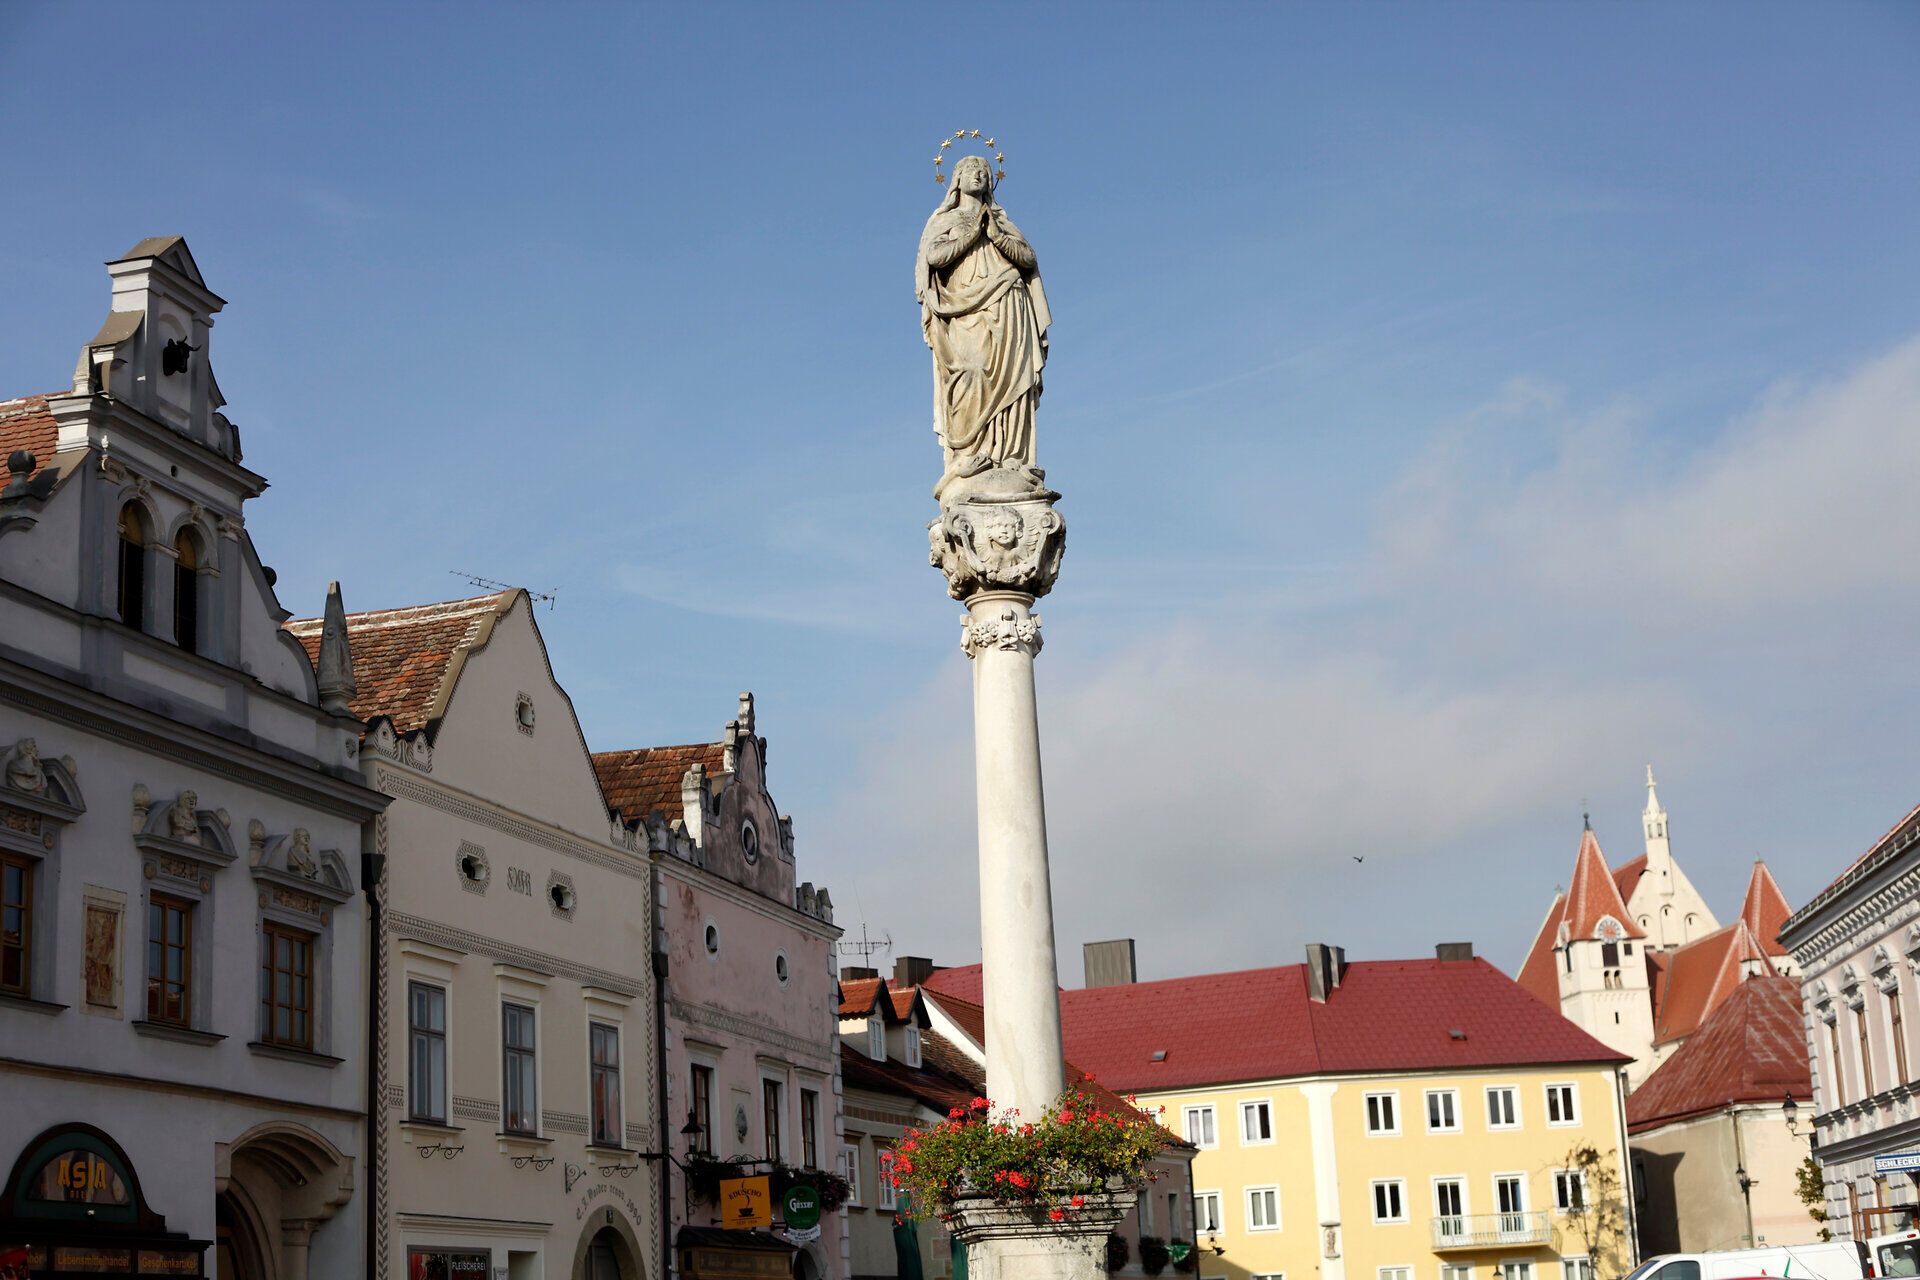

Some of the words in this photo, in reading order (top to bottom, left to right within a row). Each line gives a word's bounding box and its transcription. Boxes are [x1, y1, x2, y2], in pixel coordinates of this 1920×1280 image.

[1876, 1157, 1920, 1169] SCHLECKE
[57, 1159, 107, 1190] ASIA
[728, 1187, 762, 1201] EDUSCHO
[626, 1198, 642, 1226] 1990
[57, 1254, 129, 1267] Lebensmittelhandel
[142, 1256, 196, 1270] Geschenkartikel
[451, 1261, 487, 1271] FLEISCHEREI
